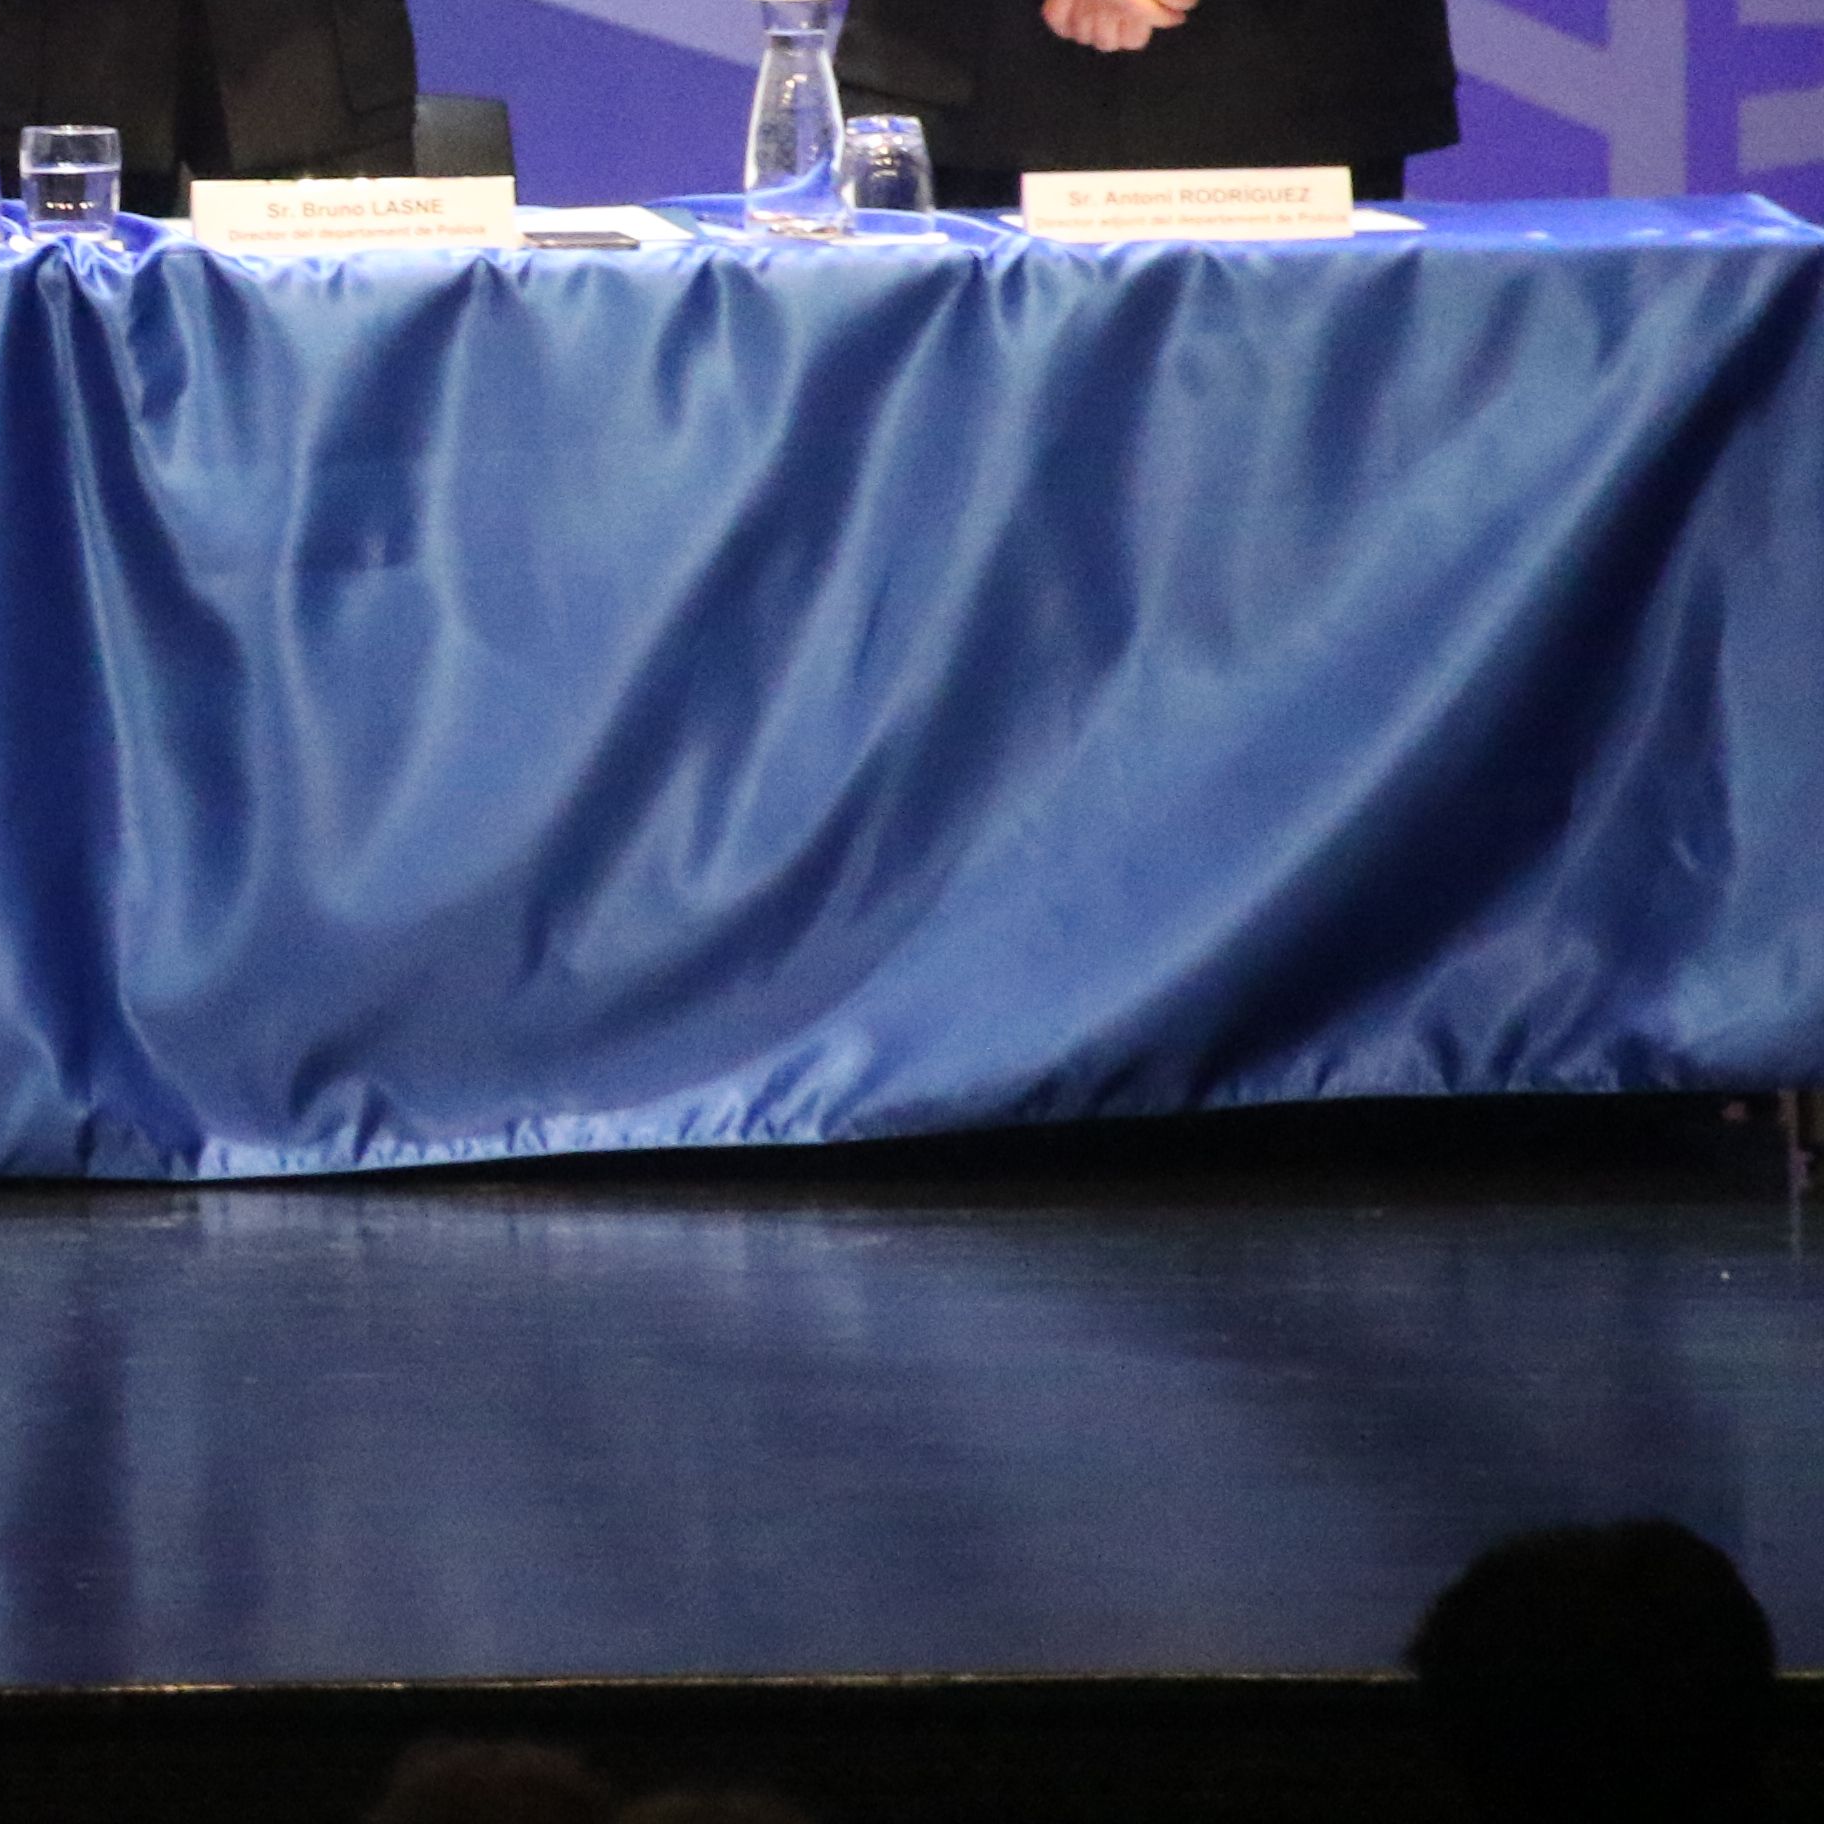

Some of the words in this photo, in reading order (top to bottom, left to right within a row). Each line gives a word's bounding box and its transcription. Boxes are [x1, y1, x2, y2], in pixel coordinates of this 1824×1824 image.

[1104, 189, 1172, 205] Antoni
[267, 201, 295, 219] Sr.
[302, 201, 365, 218] Bruno
[372, 198, 444, 216] LASNE
